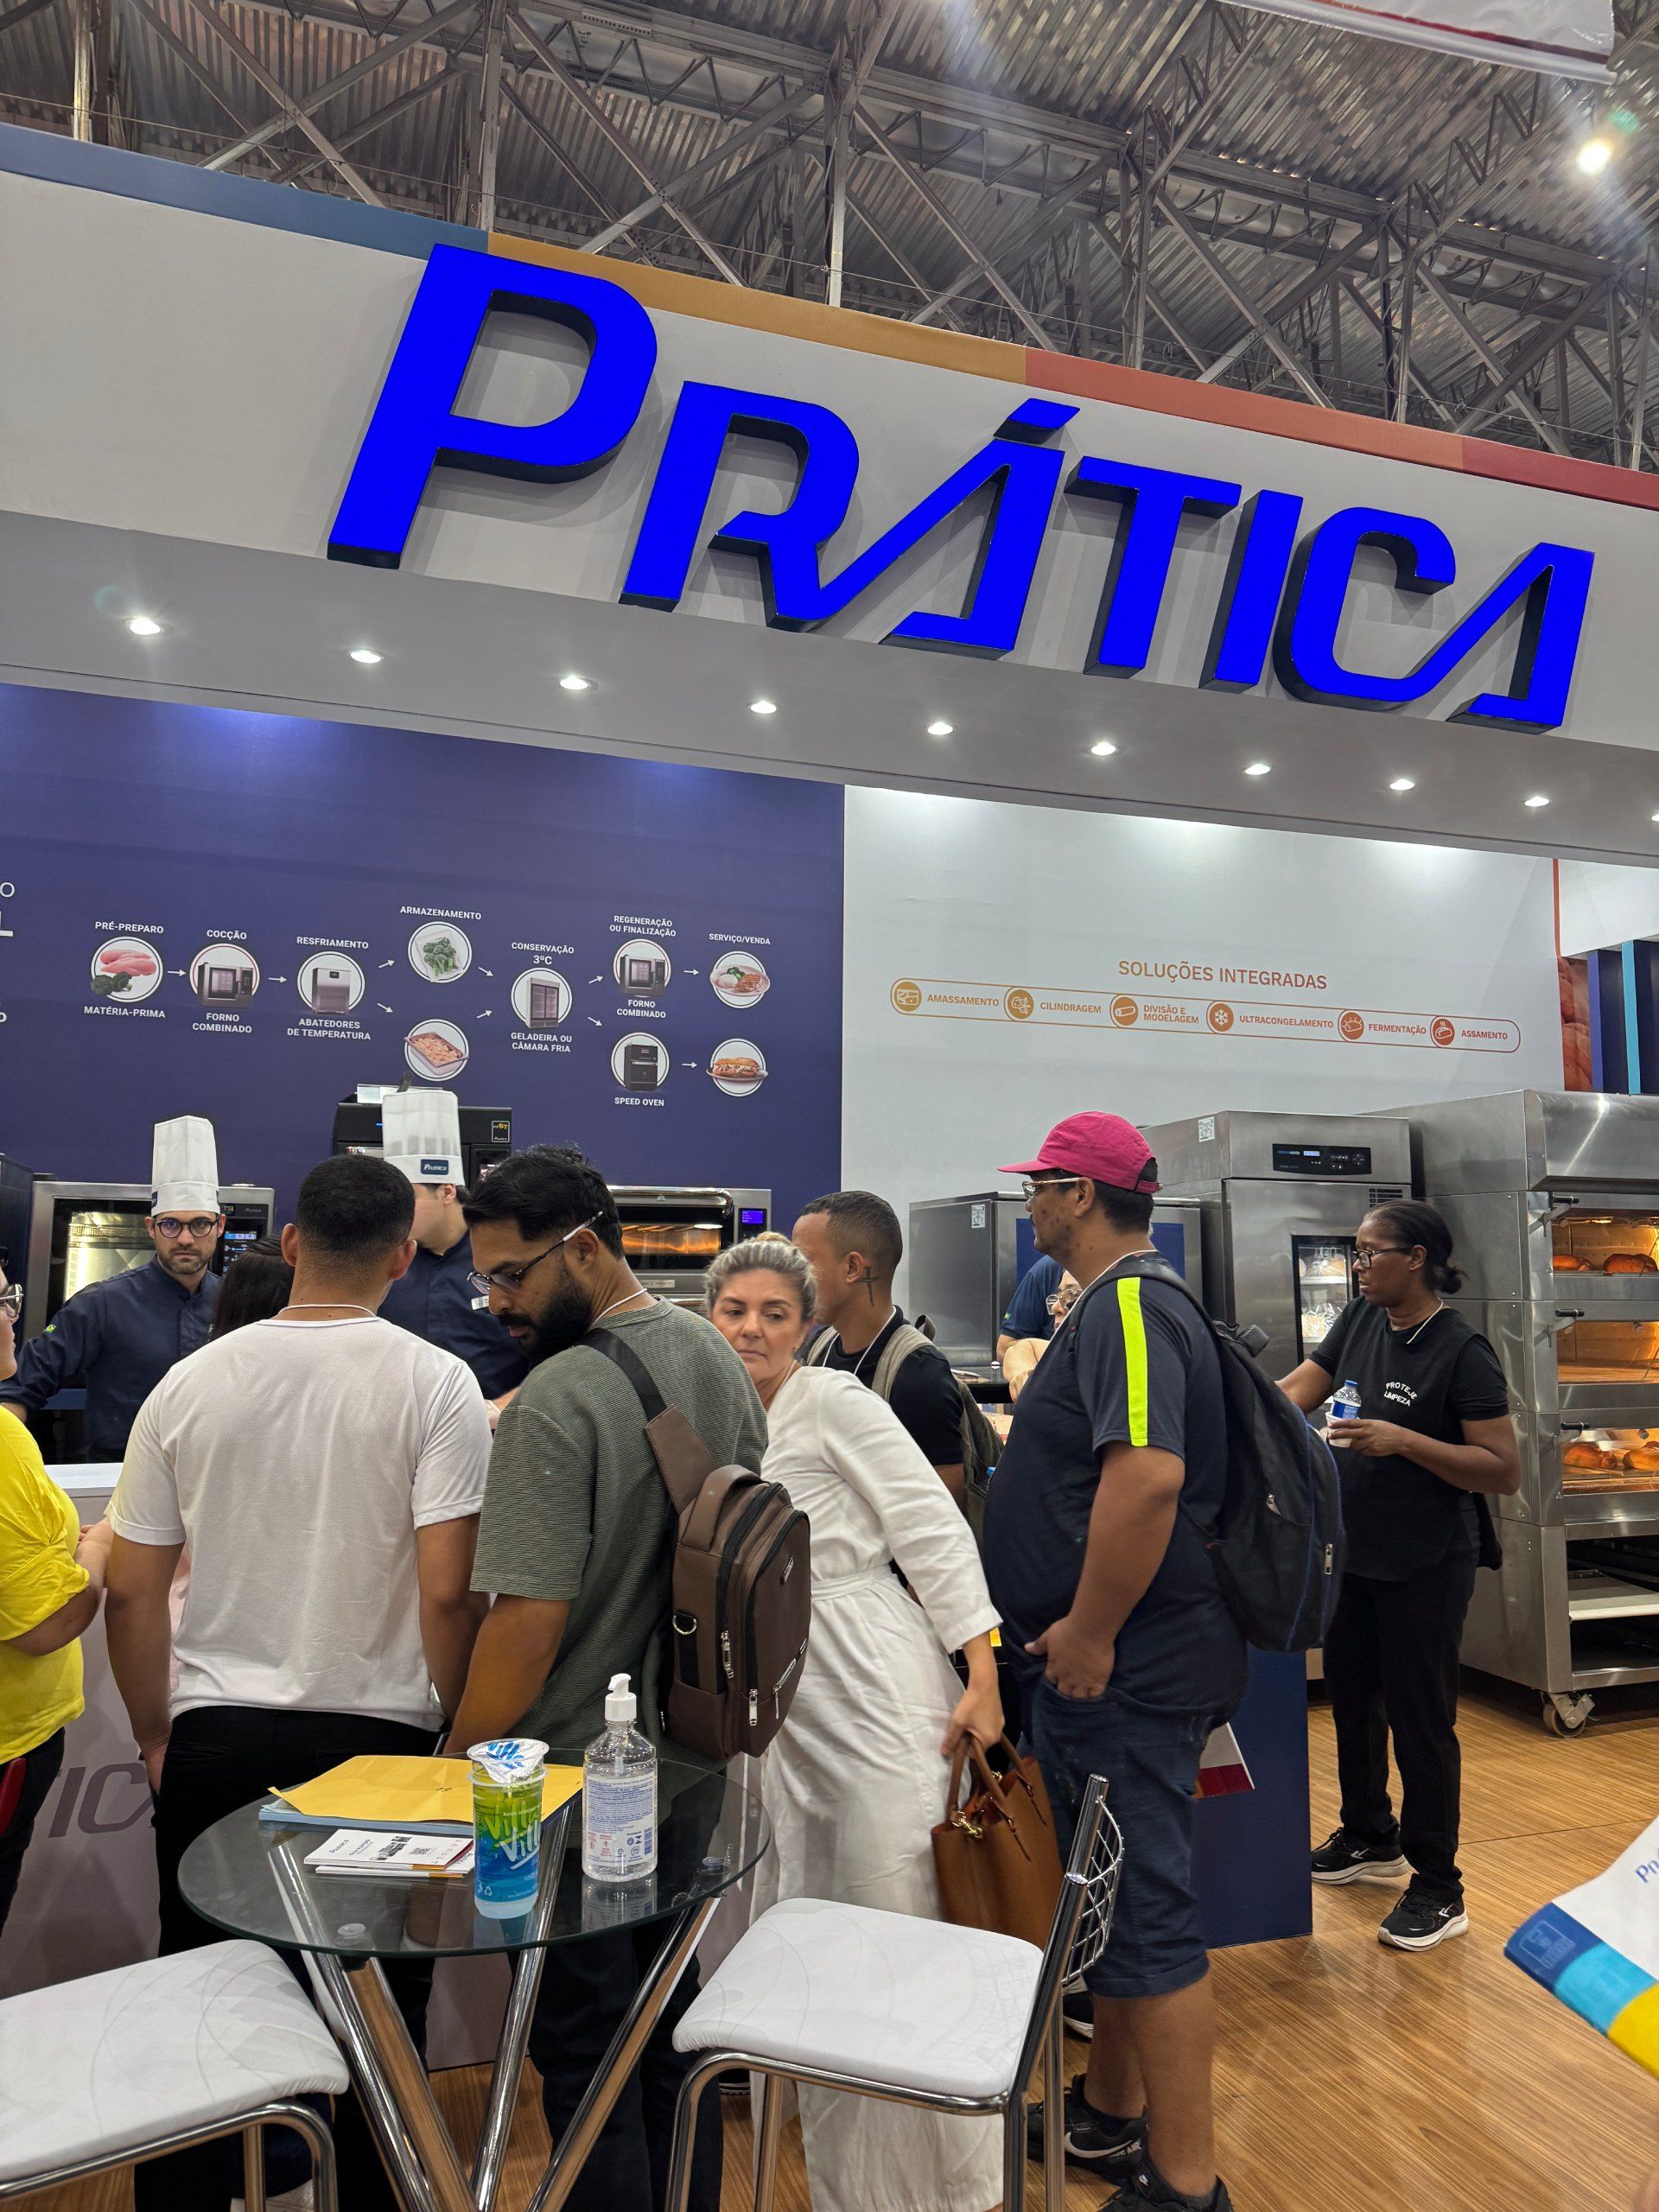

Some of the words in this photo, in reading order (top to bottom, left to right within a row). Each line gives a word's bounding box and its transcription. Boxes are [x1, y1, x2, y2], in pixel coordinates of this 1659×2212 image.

[328, 244, 1593, 728] PRÁTICA
[400, 906, 482, 919] ARMAZENAMENTO
[95, 920, 164, 933] PRÉ-PREPARO
[613, 915, 673, 928] REGENERAÇÃO
[207, 929, 247, 941] COCÇÃO
[609, 925, 620, 933] OU
[623, 925, 677, 938] FINALIZAÇÃO
[296, 937, 369, 949] RESFRIAMENTO
[709, 933, 771, 945] SERVIÇO/VENDA
[512, 942, 575, 955] CONSERVAÇÃO
[1118, 960, 1214, 983] SOLUÇÕES
[1219, 967, 1327, 990] INTEGRADAS
[627, 999, 656, 1008] FORNO
[927, 994, 1000, 1007] AMASSAMENTO
[84, 1005, 166, 1019] MATÉRIA-PRIMA
[616, 1007, 666, 1019] COMBINADO
[1039, 1001, 1102, 1014] CILINDRAGEM
[1143, 1003, 1178, 1014] DIVISÃO
[1179, 1007, 1186, 1015] E
[206, 1012, 239, 1022] FORNO
[1143, 1014, 1199, 1025] MODELAGEM
[1239, 1015, 1334, 1028] ULTRACONGELAMENTO
[192, 1021, 252, 1033] COMBINADO
[298, 1018, 360, 1030] ABATEDORES
[1368, 1023, 1427, 1036] FERMENTAÇÃO
[287, 1027, 300, 1036] DE
[302, 1028, 372, 1040] TEMPERATURA
[511, 1033, 558, 1043] GELADEIRA
[560, 1034, 573, 1044] OU
[1461, 1029, 1509, 1040] ASSAMENTO
[512, 1041, 548, 1052] CÂMARA
[550, 1044, 572, 1053] FRIA
[614, 1096, 641, 1106] SPEED
[644, 1098, 664, 1108] OVEN
[1386, 1381, 1418, 1400] PROTEJE
